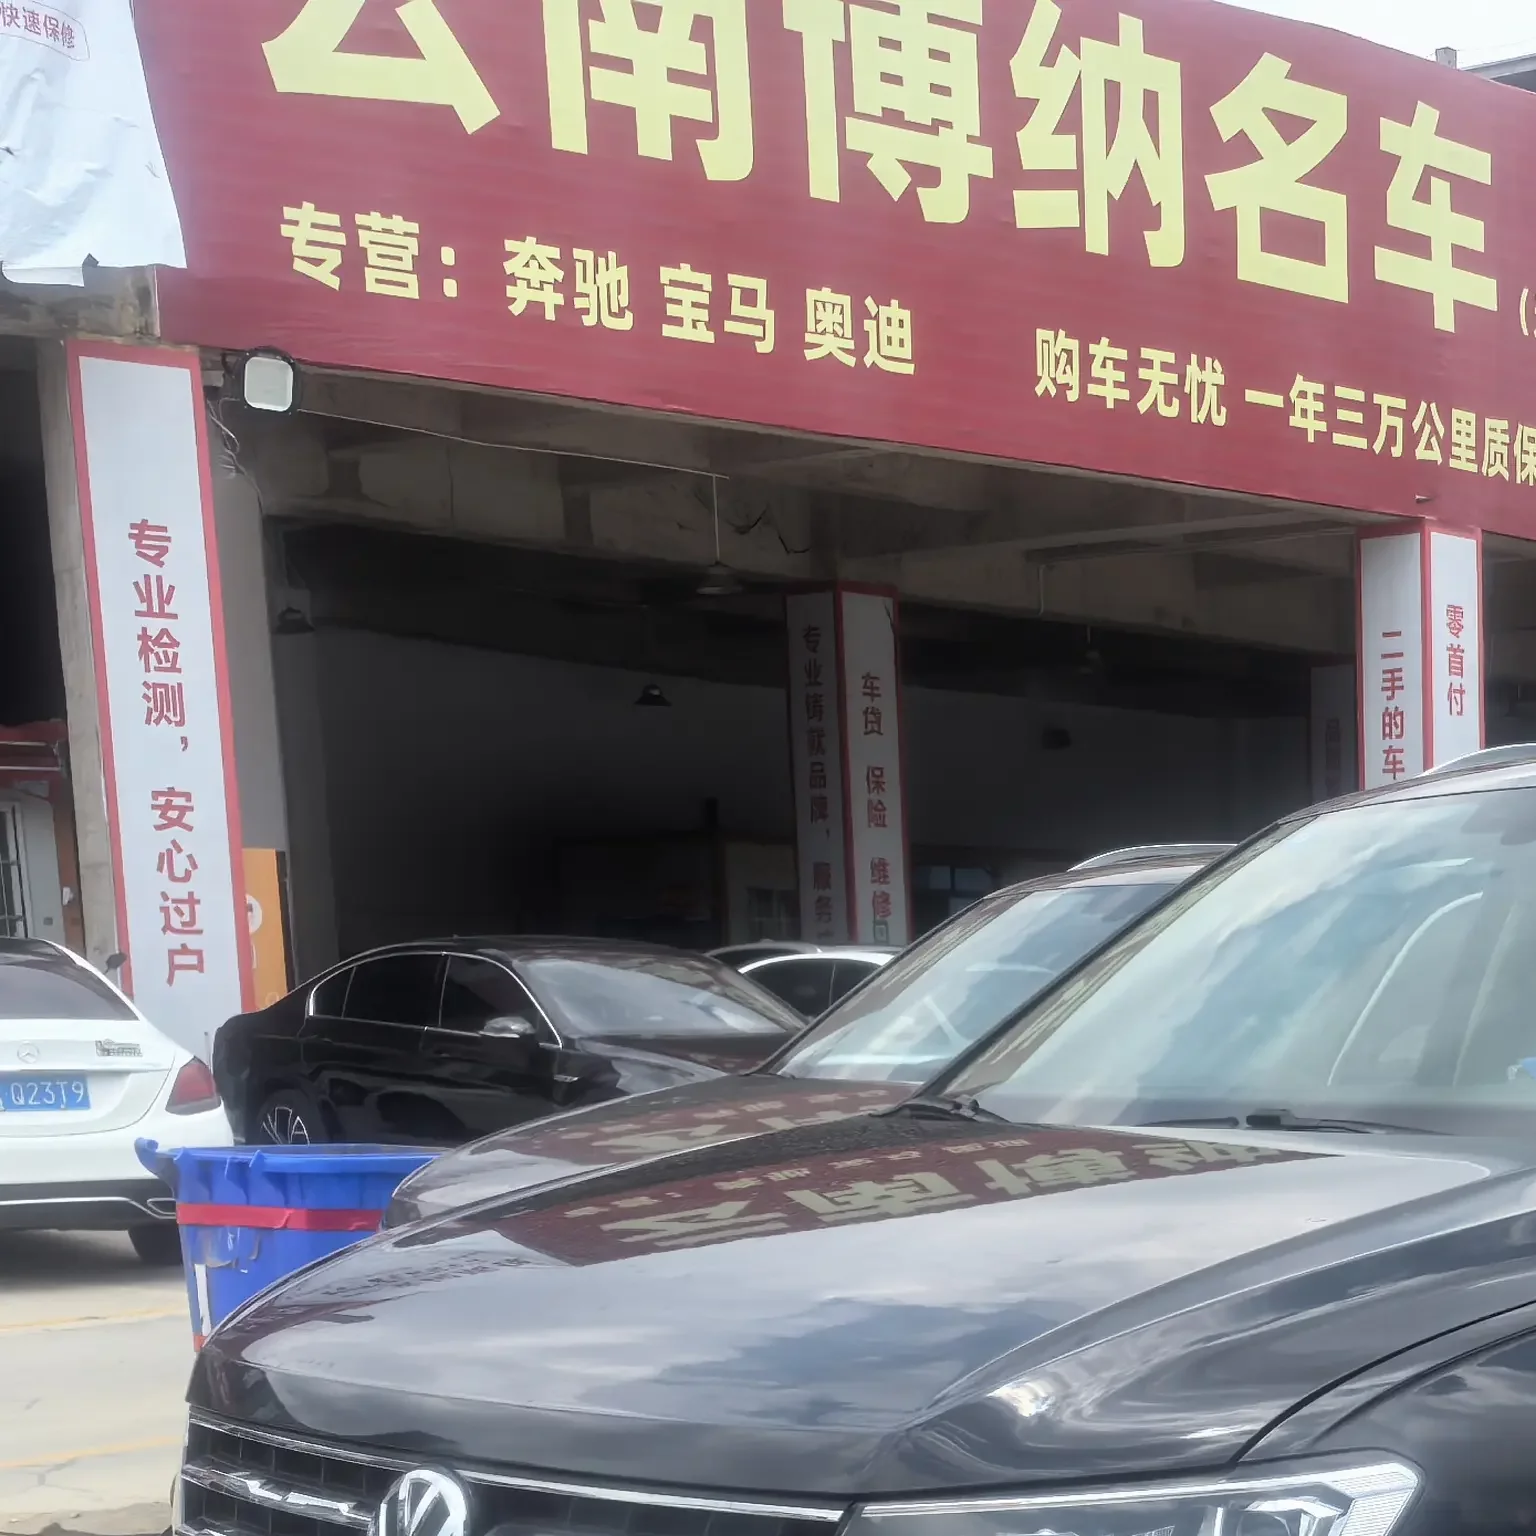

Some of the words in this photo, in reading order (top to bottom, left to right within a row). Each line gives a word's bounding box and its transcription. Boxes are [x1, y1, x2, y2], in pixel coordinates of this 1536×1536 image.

[0, 2, 75, 48] 快速保修
[661, 264, 777, 354] 宝马
[804, 287, 916, 377] 奥迪
[1034, 328, 1227, 427] 购车无忧
[1381, 630, 1405, 781] 二手的车
[1446, 604, 1466, 716] 零首付
[0, 1081, 85, 1109] Q23T9
